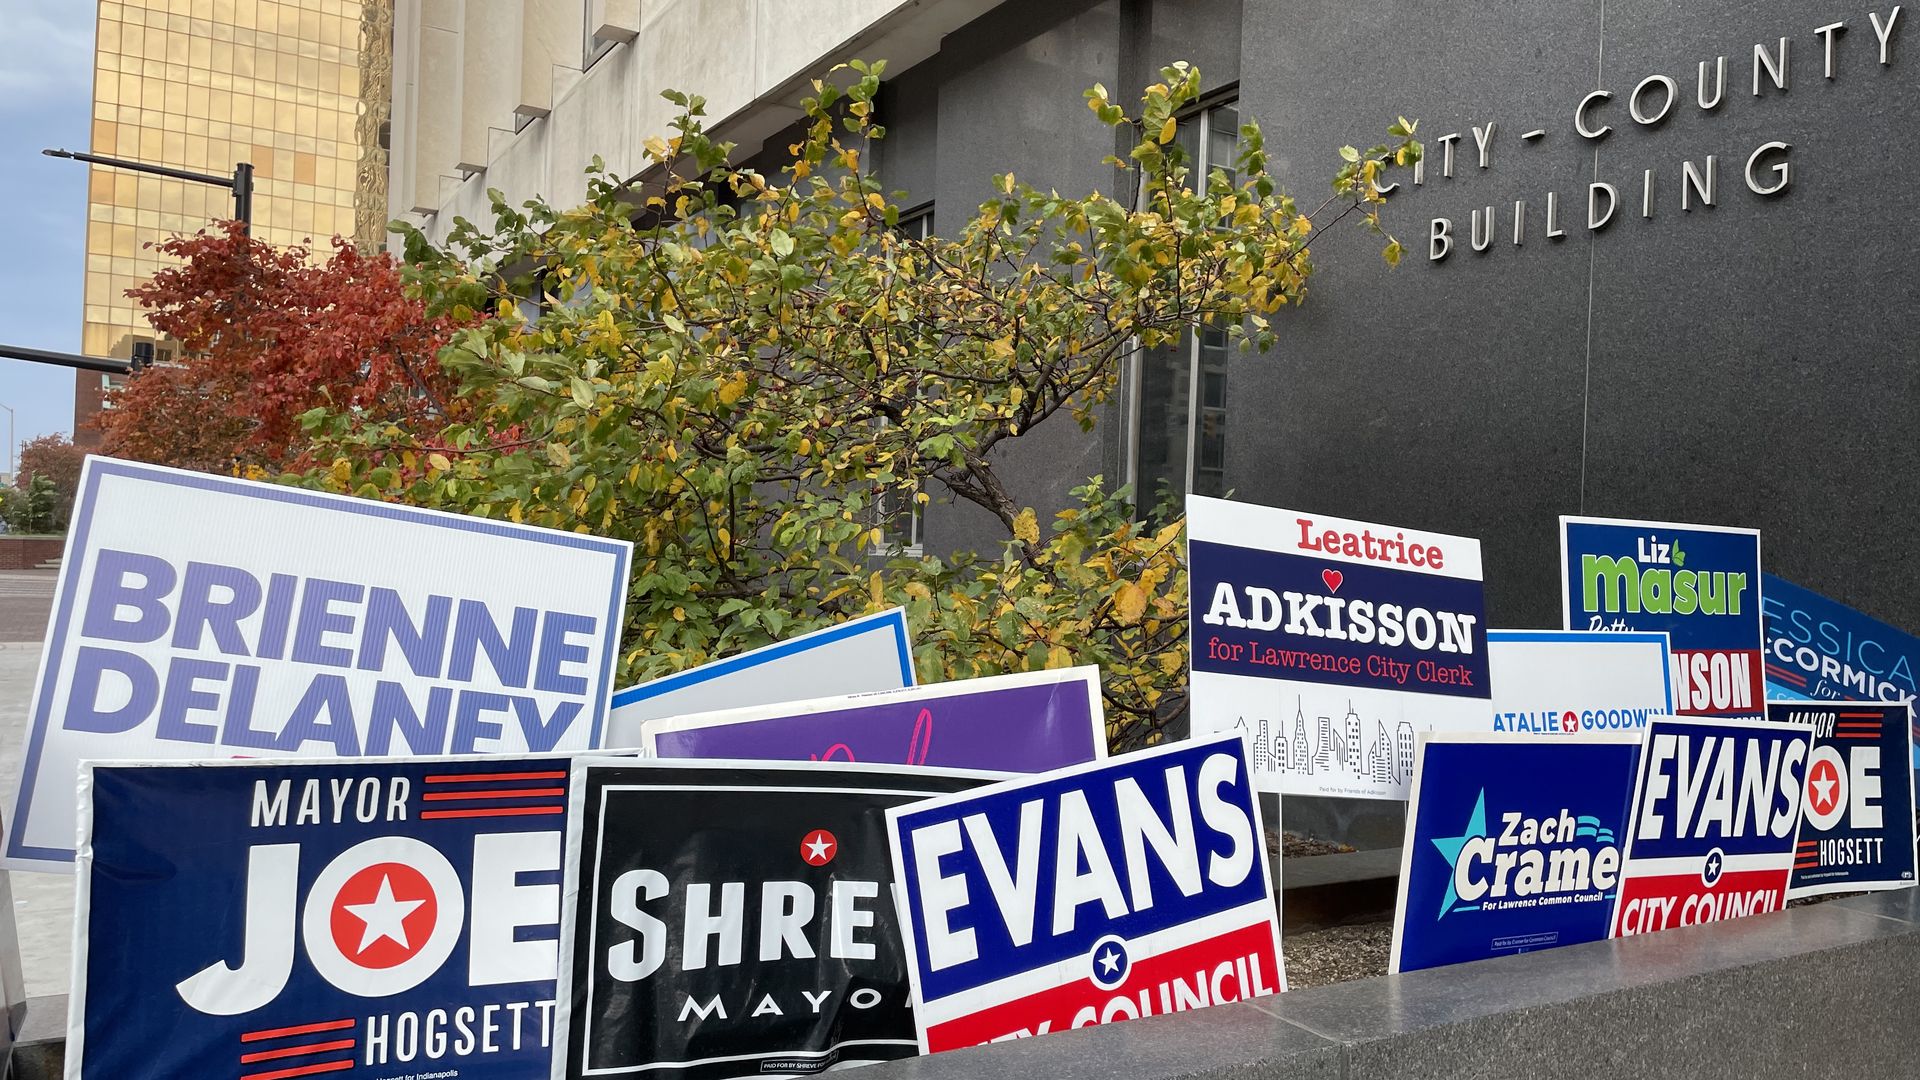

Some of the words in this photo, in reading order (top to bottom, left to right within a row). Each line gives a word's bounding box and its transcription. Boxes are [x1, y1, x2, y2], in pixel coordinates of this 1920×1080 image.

[1371, 122, 1497, 193] CITY
[1574, 6, 1901, 139] COUNTY
[1429, 141, 1793, 262] BUILDING
[1296, 519, 1444, 570] Leatrice
[1637, 535, 1670, 564] Liz
[80, 548, 598, 696] BRIENNE
[1202, 582, 1476, 654] ADKISSON
[1208, 637, 1244, 662] for
[1249, 641, 1361, 674] Lawrence
[1367, 655, 1411, 684] City
[1416, 660, 1474, 687] Clerk
[1764, 637, 1918, 718] CORMICK
[62, 646, 585, 757] DELANEY
[1809, 679, 1841, 700] for
[1581, 708, 1664, 731] GOODW
[250, 776, 411, 827] MAYOR
[1638, 734, 1807, 839] EVANS
[1498, 808, 1577, 847] Zach
[1820, 838, 1883, 866] HOGSETT
[911, 752, 1256, 973] EVANS
[175, 830, 561, 1015] JOE
[607, 869, 908, 983] SHRE
[1482, 902, 1497, 911] For
[1498, 898, 1537, 910] Lawrence
[1538, 895, 1572, 906] Common
[1574, 892, 1603, 903] Council
[1621, 895, 1678, 937] CITY
[1680, 889, 1778, 928] COUNCIL
[677, 987, 912, 1022] MAYO
[366, 1001, 556, 1065] HOGSETT
[416, 1069, 458, 1080] Indianapolis
